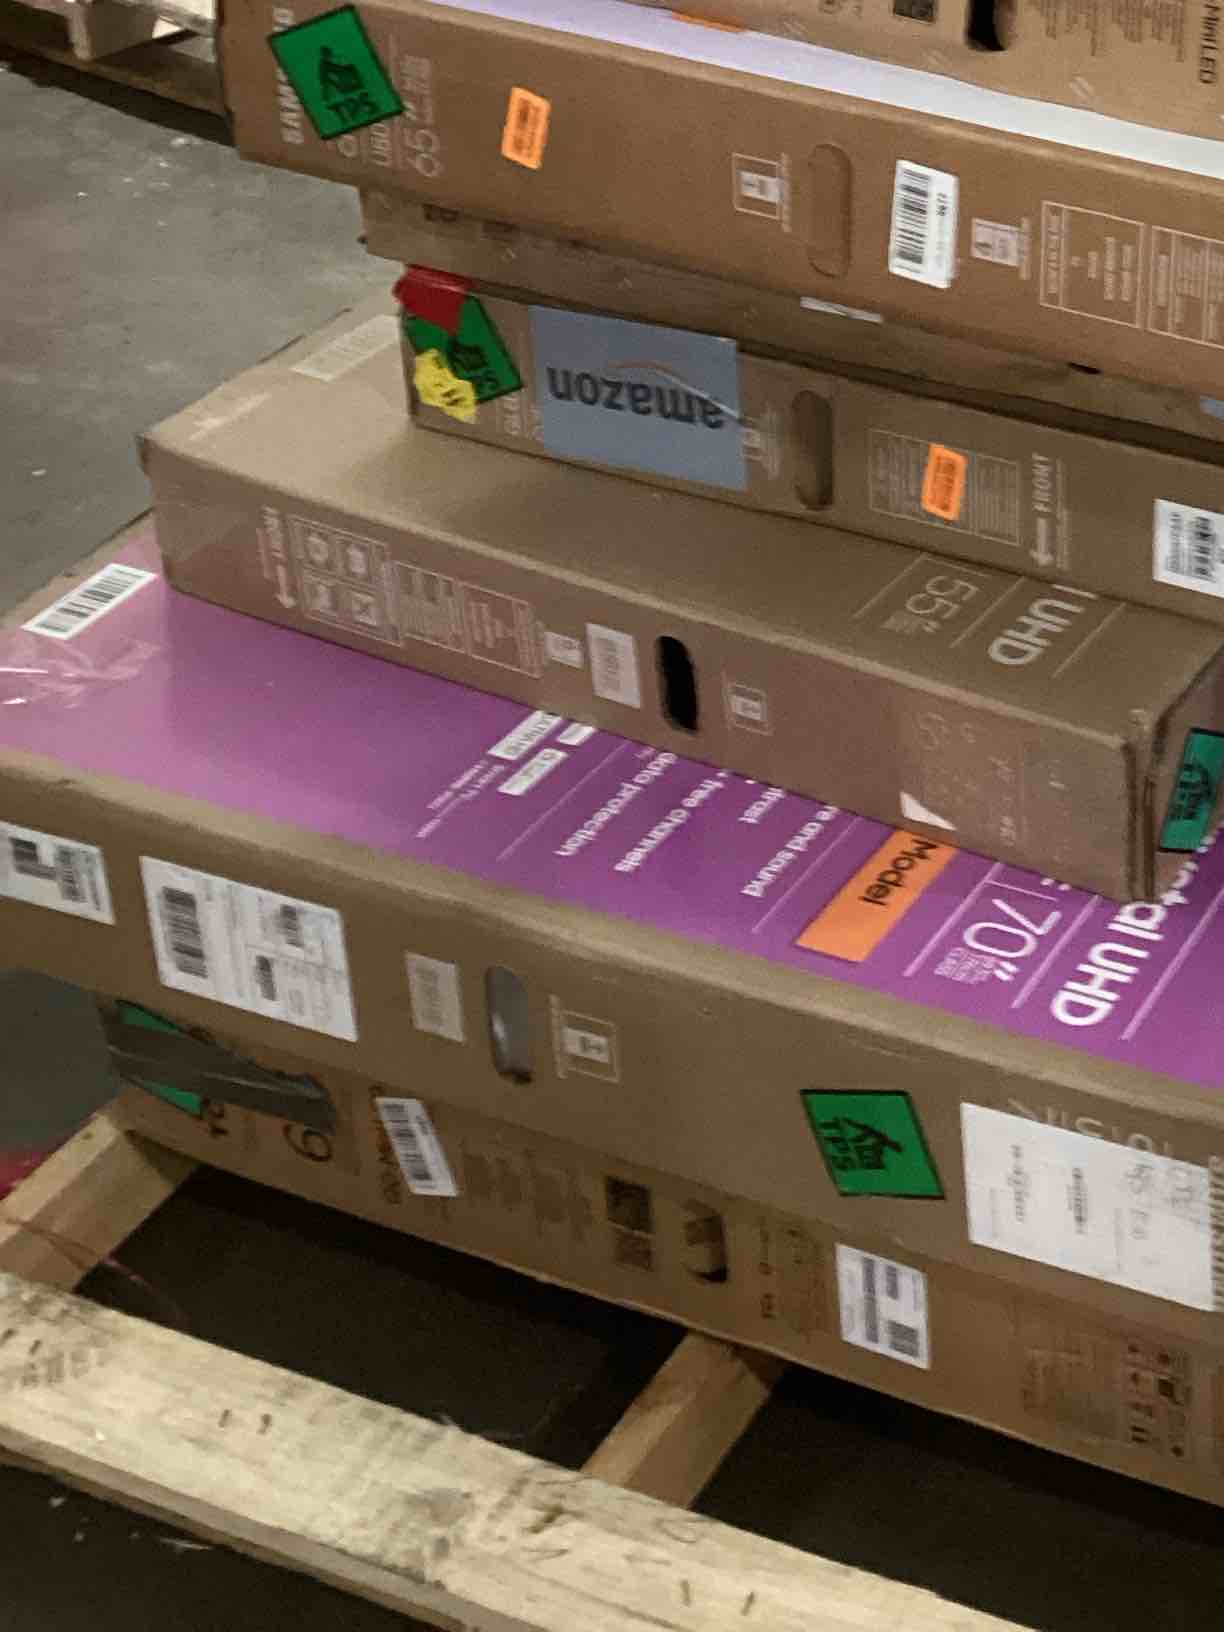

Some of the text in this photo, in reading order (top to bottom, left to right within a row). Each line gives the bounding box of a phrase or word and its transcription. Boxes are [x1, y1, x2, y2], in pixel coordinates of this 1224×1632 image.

[546, 364, 723, 429] amazon
[554, 781, 644, 857] protection
[613, 806, 690, 873] channels
[738, 820, 825, 898] and sound
[857, 837, 938, 907] Model
[1050, 940, 1151, 1028] UHD
